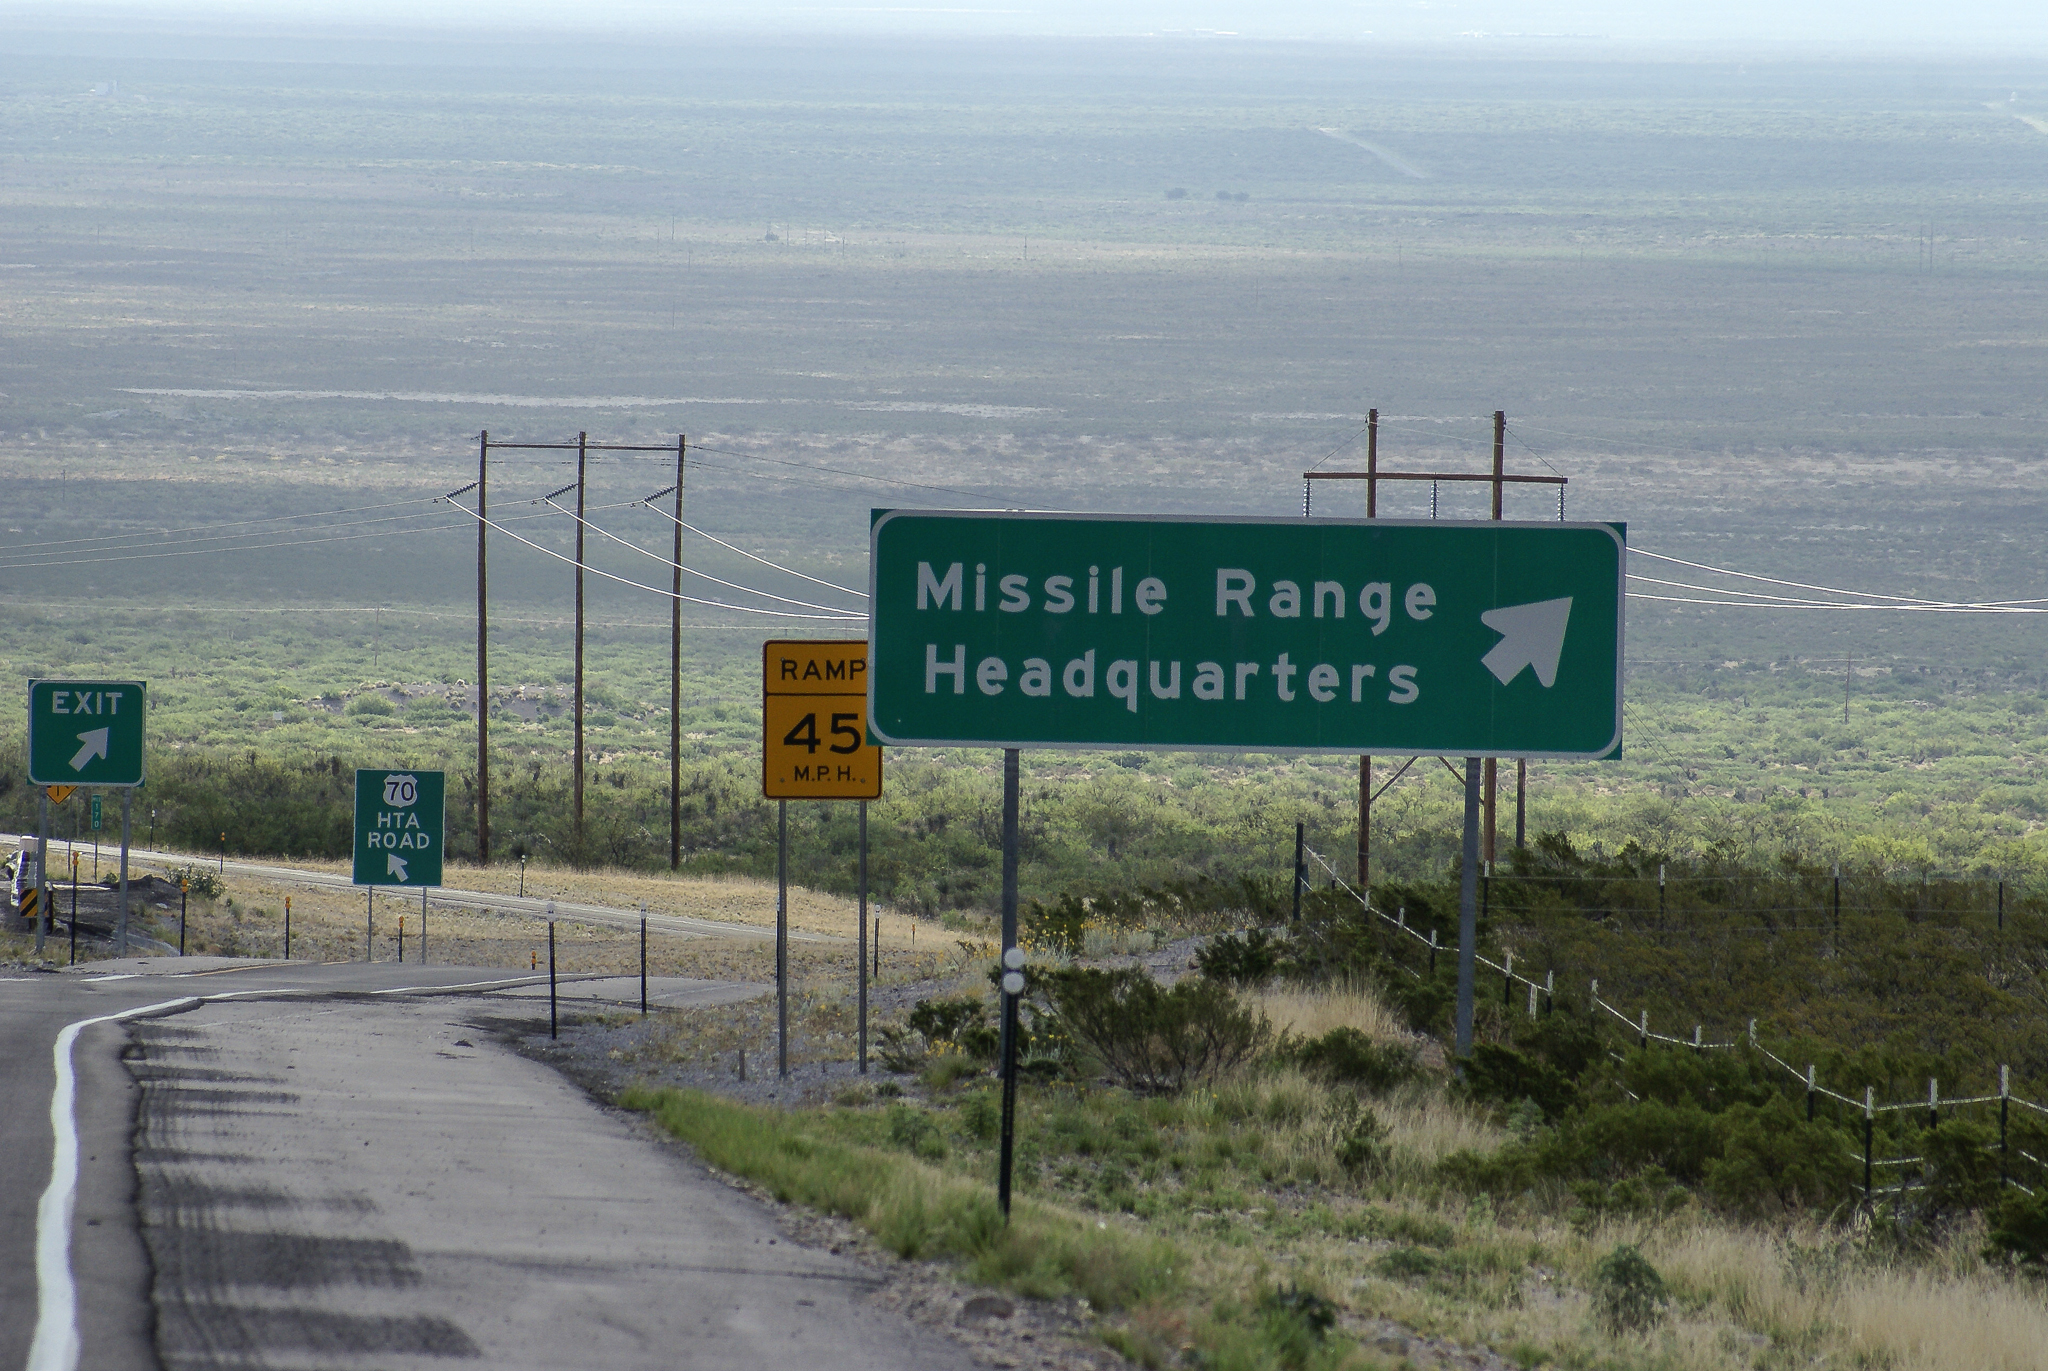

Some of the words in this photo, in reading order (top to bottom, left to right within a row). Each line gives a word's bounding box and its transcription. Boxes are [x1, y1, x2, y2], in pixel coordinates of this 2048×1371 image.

[917, 561, 1168, 615] Missile
[1215, 568, 1438, 637] Range
[781, 659, 867, 681] RAMP
[924, 643, 1420, 714] Headquarters
[52, 690, 123, 715] EXIT
[783, 712, 862, 755] 45
[794, 765, 856, 782] M.P.H.
[386, 781, 415, 802] 70
[377, 811, 420, 829] HTA
[367, 831, 430, 850] ROAD
